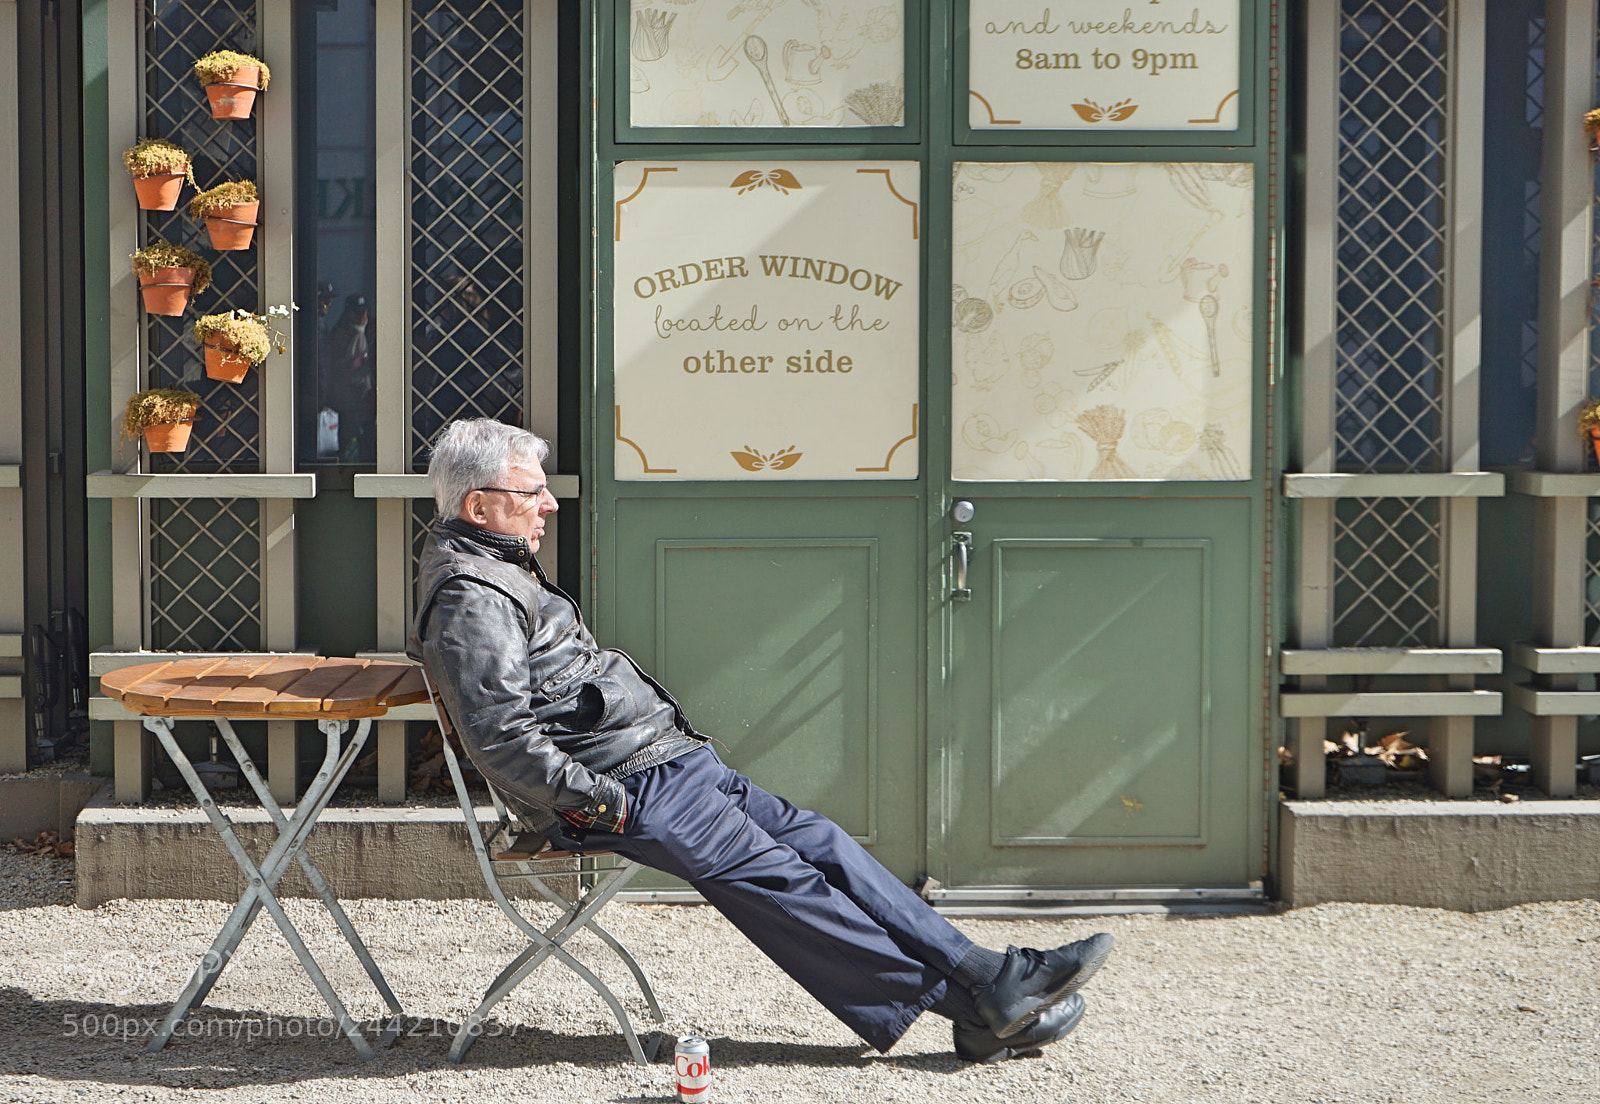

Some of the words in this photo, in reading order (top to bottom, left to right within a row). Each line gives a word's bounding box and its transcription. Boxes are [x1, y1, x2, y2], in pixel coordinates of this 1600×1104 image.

[984, 7, 1060, 35] and
[1068, 7, 1228, 35] weekends
[1015, 48, 1082, 70] 8am
[1091, 47, 1121, 70] to
[1131, 48, 1199, 76] 9pm
[633, 256, 749, 299] ORDER
[759, 254, 903, 301] WINDOW
[654, 304, 768, 339] located
[777, 317, 824, 332] on
[829, 304, 891, 332] the
[682, 349, 774, 374] other
[785, 349, 854, 374] side
